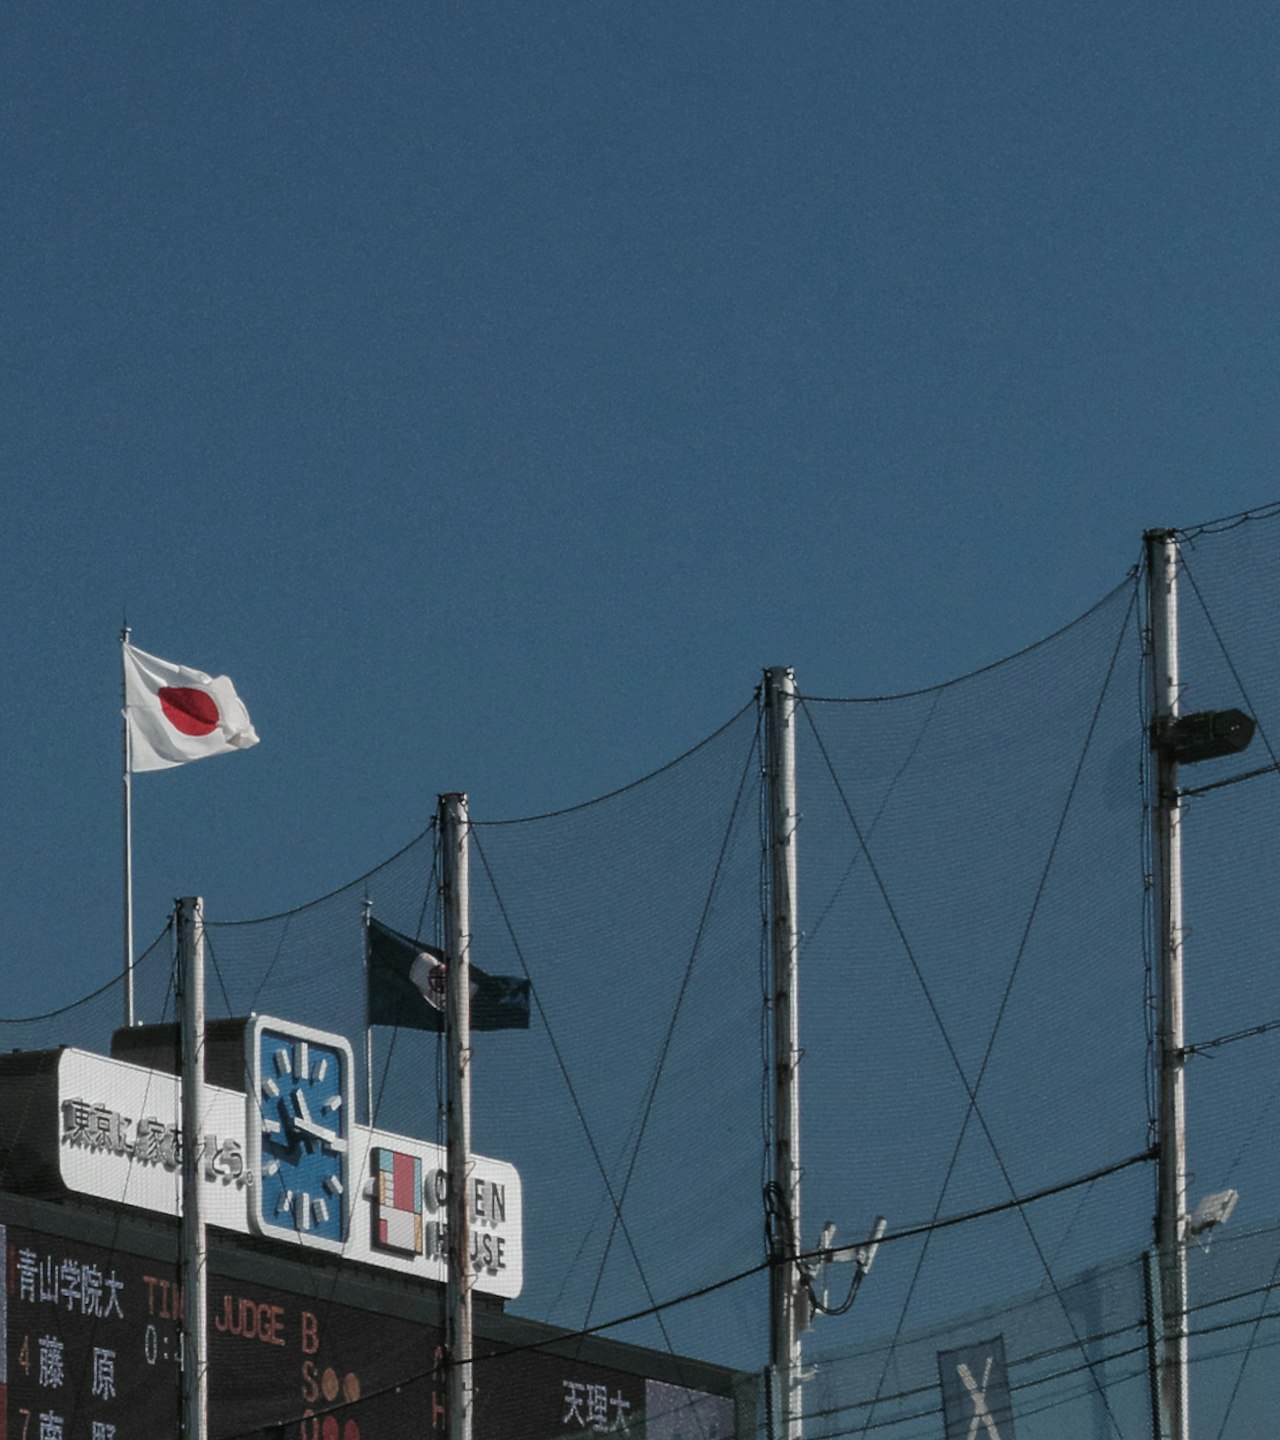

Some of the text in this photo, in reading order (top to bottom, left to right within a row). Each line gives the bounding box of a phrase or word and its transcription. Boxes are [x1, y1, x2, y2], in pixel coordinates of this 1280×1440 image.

[65, 1098, 254, 1187] 東京に家をとう。
[434, 1170, 505, 1223] OEN
[434, 1221, 507, 1269] HUSE
[16, 1248, 124, 1319] 青山学院大
[214, 1294, 286, 1346] JUDGE
[301, 1312, 318, 1354] B
[19, 1334, 31, 1377] 4
[301, 1360, 319, 1403] S
[562, 1379, 631, 1434] 天理大
